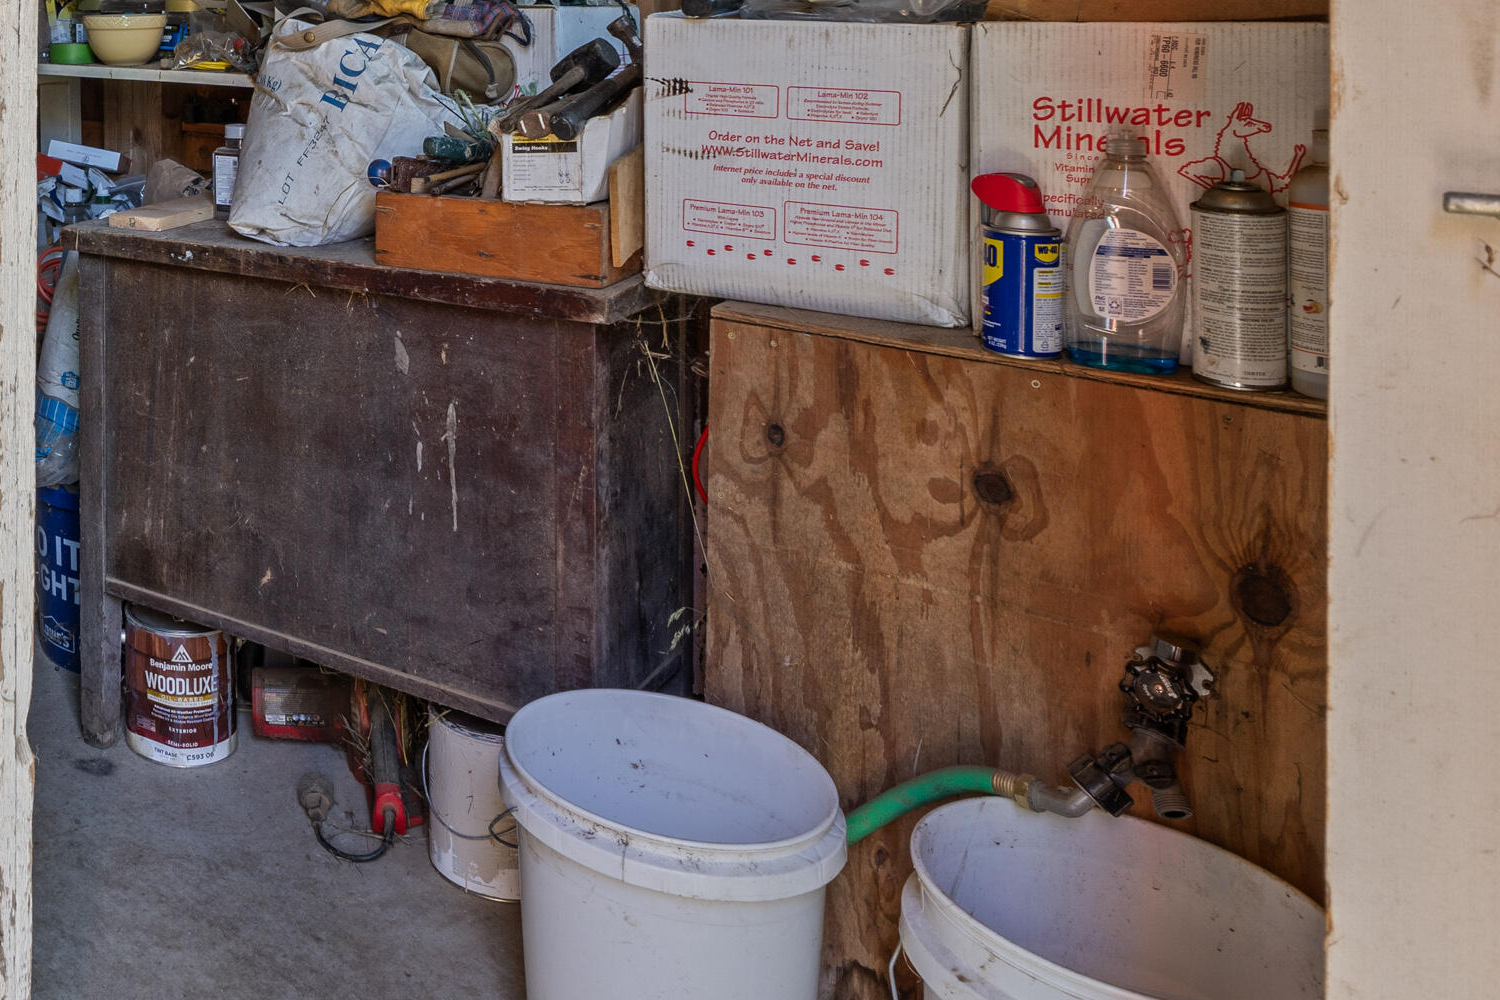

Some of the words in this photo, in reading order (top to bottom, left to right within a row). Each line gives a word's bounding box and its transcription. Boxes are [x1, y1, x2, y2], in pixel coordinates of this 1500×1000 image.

[319, 37, 387, 112] BICA
[855, 92, 869, 100] 102
[1032, 96, 1212, 128] Stillwater
[708, 129, 742, 142] Order
[745, 135, 760, 144] on
[763, 134, 786, 146] the
[789, 135, 813, 147] Net
[816, 138, 841, 149] and
[844, 139, 880, 152] Save!
[1033, 124, 1187, 156] Minels
[701, 144, 883, 168] WWW.StillwaterMinerals.com
[1066, 152, 1100, 161] Since
[713, 163, 743, 174] Internet
[743, 167, 764, 176] price
[765, 167, 797, 178] includes
[806, 172, 833, 181] special
[835, 173, 871, 184] discount
[278, 172, 295, 205] LOT
[741, 176, 758, 186] only
[759, 177, 794, 187] available
[807, 181, 821, 189] the
[821, 183, 838, 191] net.
[1043, 193, 1105, 208] pecifically
[800, 207, 830, 217] Premium
[1044, 207, 1106, 220] ormulated
[1037, 245, 1058, 255] WD-40
[149, 658, 186, 672] Benjamin
[187, 663, 214, 672] Moore
[144, 670, 218, 695] WOODLUXE
[168, 726, 197, 734] EXTERIOR
[167, 739, 199, 748] SEMI-SOLID
[154, 746, 165, 755] TINT
[164, 750, 178, 758] BASE
[186, 752, 205, 761] C593
